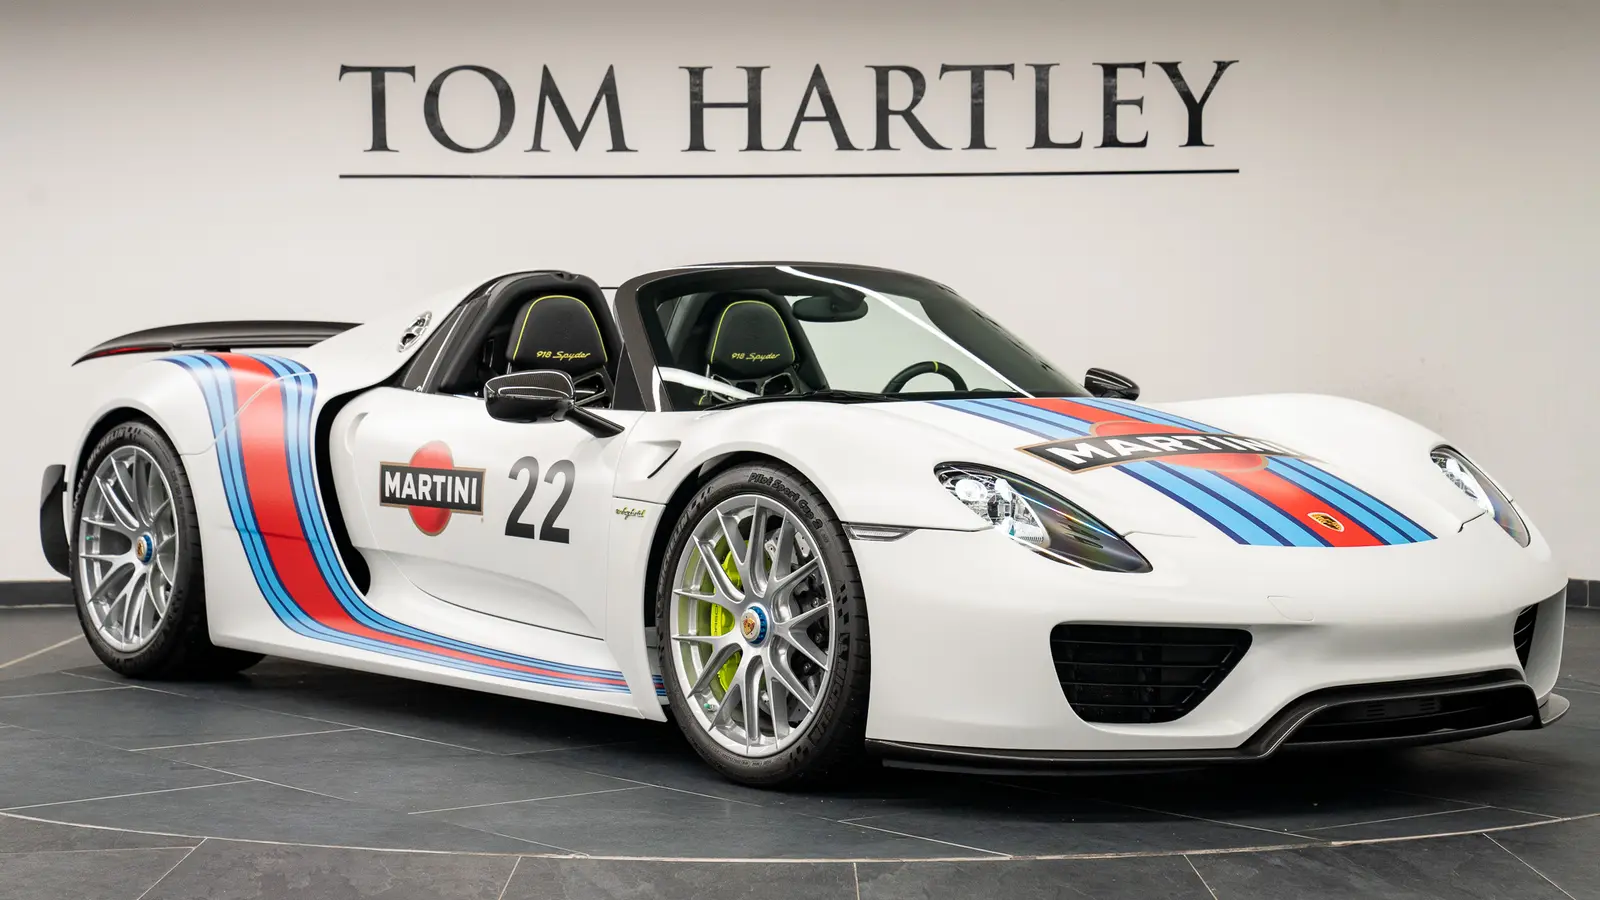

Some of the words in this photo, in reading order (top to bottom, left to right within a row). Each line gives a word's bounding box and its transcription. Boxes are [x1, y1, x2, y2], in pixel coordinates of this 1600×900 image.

[338, 63, 638, 154] TOM
[678, 59, 1240, 153] HARTLEY
[536, 350, 552, 359] 918
[552, 350, 591, 361] Spyder
[731, 352, 745, 360] 918
[746, 352, 781, 362] Spyder
[1045, 434, 1300, 465] MARTINI
[384, 470, 478, 505] MARTINI
[504, 455, 576, 545] 22
[748, 472, 773, 487] Pilot
[772, 479, 801, 503] Sport
[798, 499, 815, 520] Cup
[812, 518, 824, 530] 2
